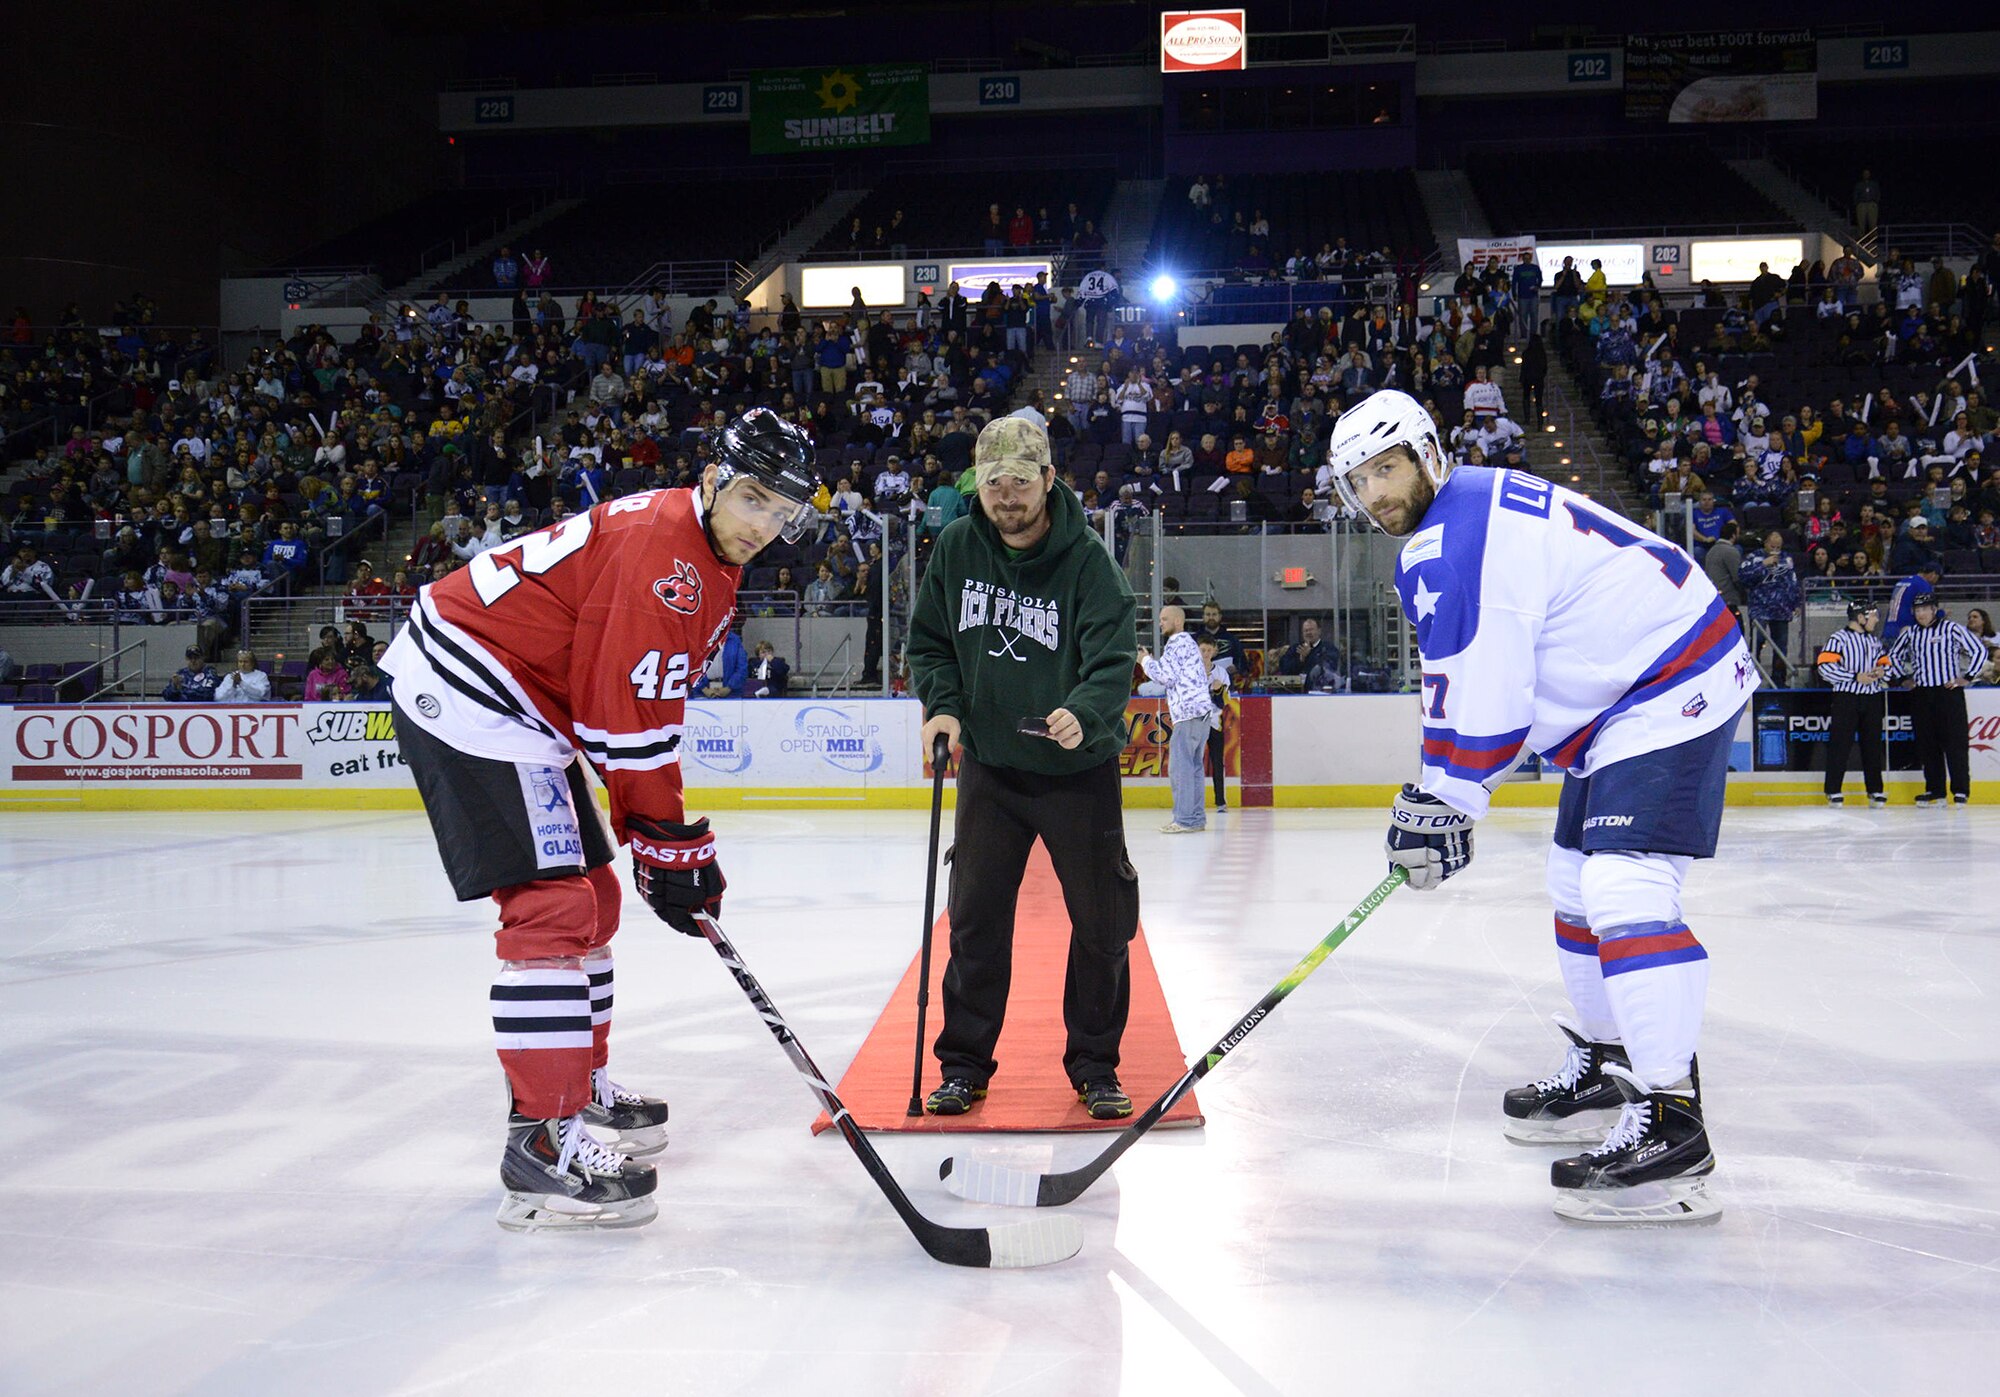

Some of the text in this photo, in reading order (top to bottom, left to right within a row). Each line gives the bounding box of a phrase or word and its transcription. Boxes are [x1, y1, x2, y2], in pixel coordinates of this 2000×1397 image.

[1167, 35, 1241, 45] ALL PRO SOUND
[1654, 36, 1684, 50] your
[1688, 33, 1716, 48] best
[1719, 32, 1754, 48] FOOT
[1757, 28, 1816, 45] forward.
[1870, 44, 1903, 64] 203
[1573, 56, 1605, 80] 202
[709, 91, 737, 109] 229
[985, 82, 1015, 100] 230
[480, 101, 508, 119] 228
[784, 113, 896, 139] SUNBELT
[800, 135, 880, 148] RENTALS
[1655, 247, 1678, 262] 202
[916, 267, 937, 281] 230
[1088, 276, 1104, 292] 34
[1117, 306, 1143, 322] 101
[1506, 469, 1550, 510] LU
[959, 588, 988, 633] ICE
[628, 649, 689, 700] 42
[1422, 672, 1450, 719] 7
[15, 714, 299, 760] GOSPORT
[306, 711, 396, 746] SUBW
[681, 725, 749, 738] TAND-UP
[807, 725, 879, 738] STAND-UP
[1790, 731, 1830, 742] POWE
[697, 739, 734, 752] MRI
[781, 739, 864, 753] OPEN MRI
[64, 765, 251, 778] www.gosportpensacola.com
[330, 750, 408, 776] eat fre
[1391, 805, 1467, 828] ASTON
[537, 824, 562, 836] HOPE
[543, 839, 582, 856] GLASS
[632, 837, 717, 864] EASTO
[693, 868, 701, 886] PRO
[1356, 871, 1403, 917] REGIONS
[1218, 1006, 1267, 1054] REGIONS
